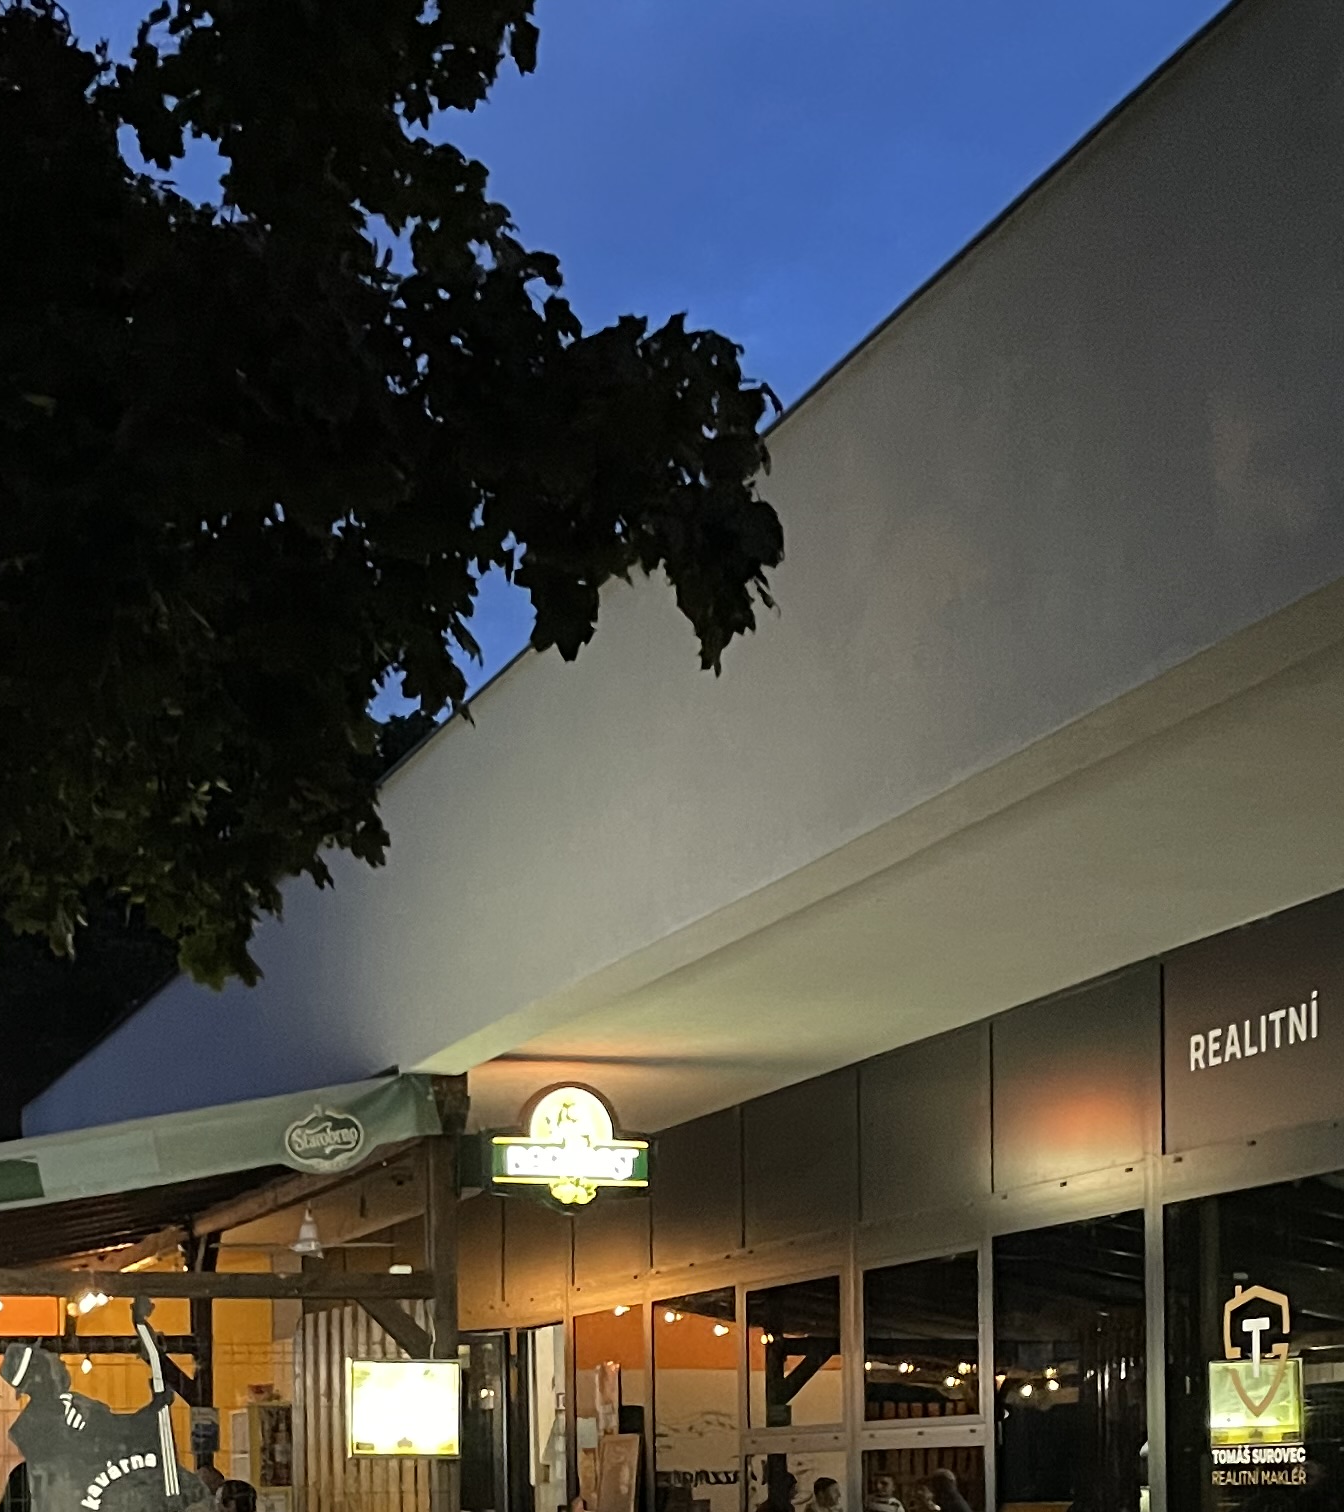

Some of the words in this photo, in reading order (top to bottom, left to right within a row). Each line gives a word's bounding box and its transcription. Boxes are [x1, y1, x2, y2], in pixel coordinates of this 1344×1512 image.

[1189, 990, 1319, 1071] REALITNÍ
[1211, 1445, 1251, 1465] TOMÁŠ
[1252, 1447, 1306, 1464] SUROVEC
[81, 1453, 157, 1511] kavárna
[1211, 1467, 1259, 1485] REALITNÍ
[1261, 1465, 1306, 1485] MAKLÉŘ
